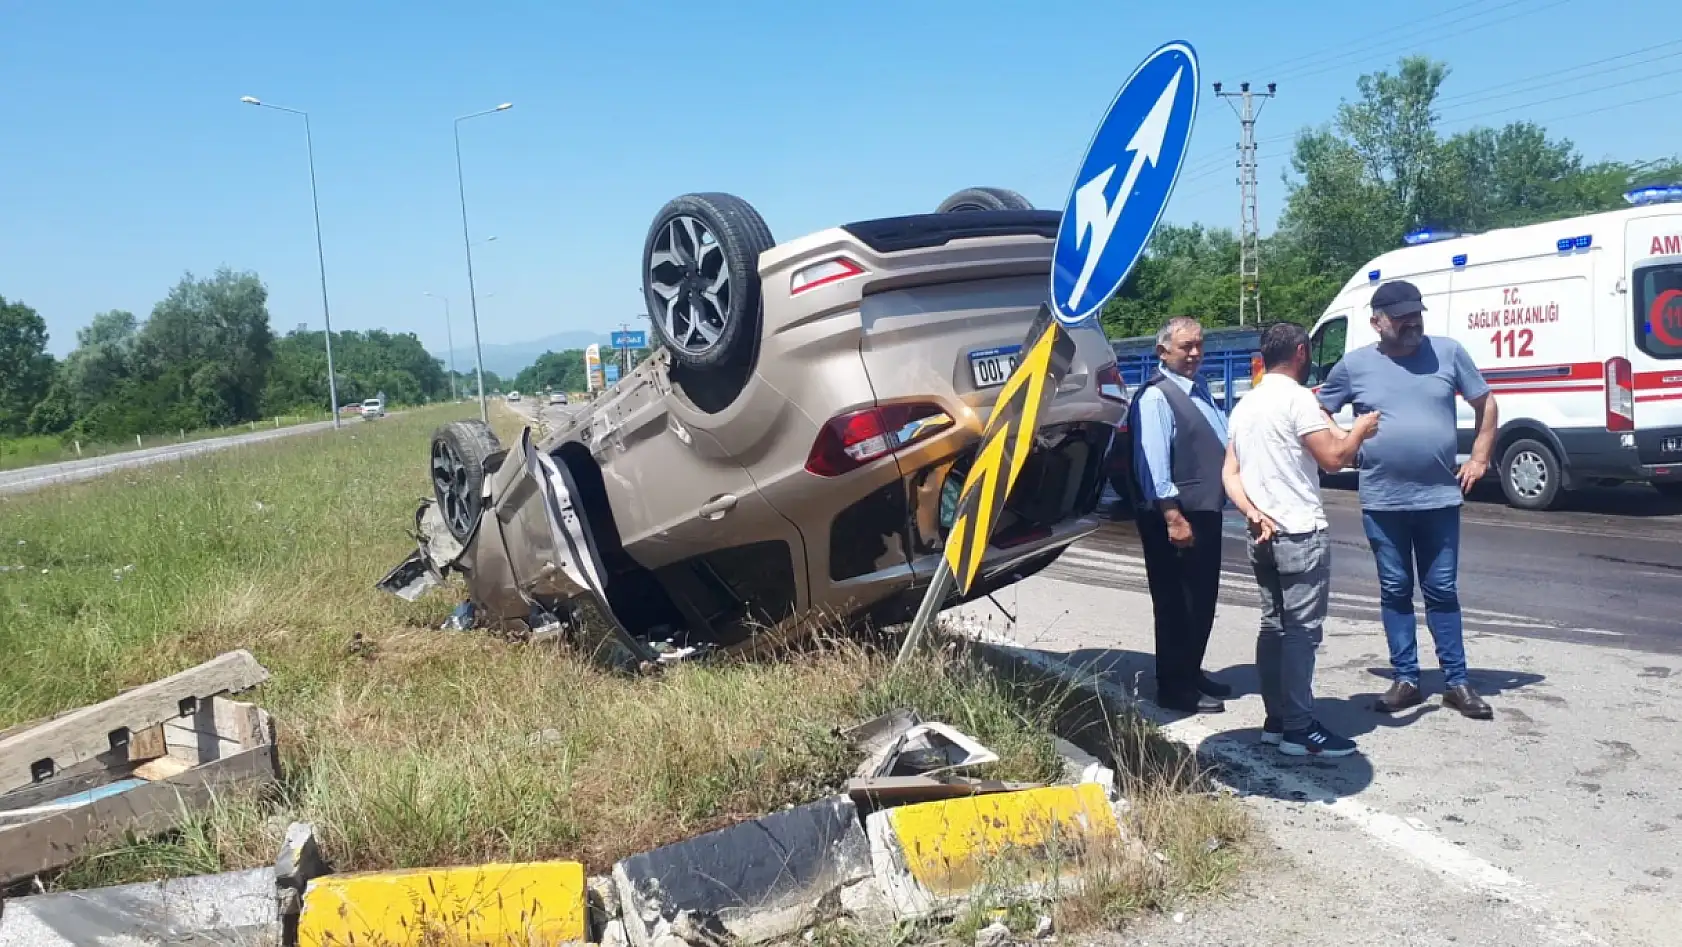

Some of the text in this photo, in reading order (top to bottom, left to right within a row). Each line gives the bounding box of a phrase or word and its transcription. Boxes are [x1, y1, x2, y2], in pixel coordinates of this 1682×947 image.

[1650, 235, 1682, 255] AM
[1503, 287, 1521, 305] T.C.
[1467, 301, 1559, 330] SAĞLIK BAKANLIĞI
[1490, 328, 1534, 358] 112
[978, 358, 1004, 382] 100
